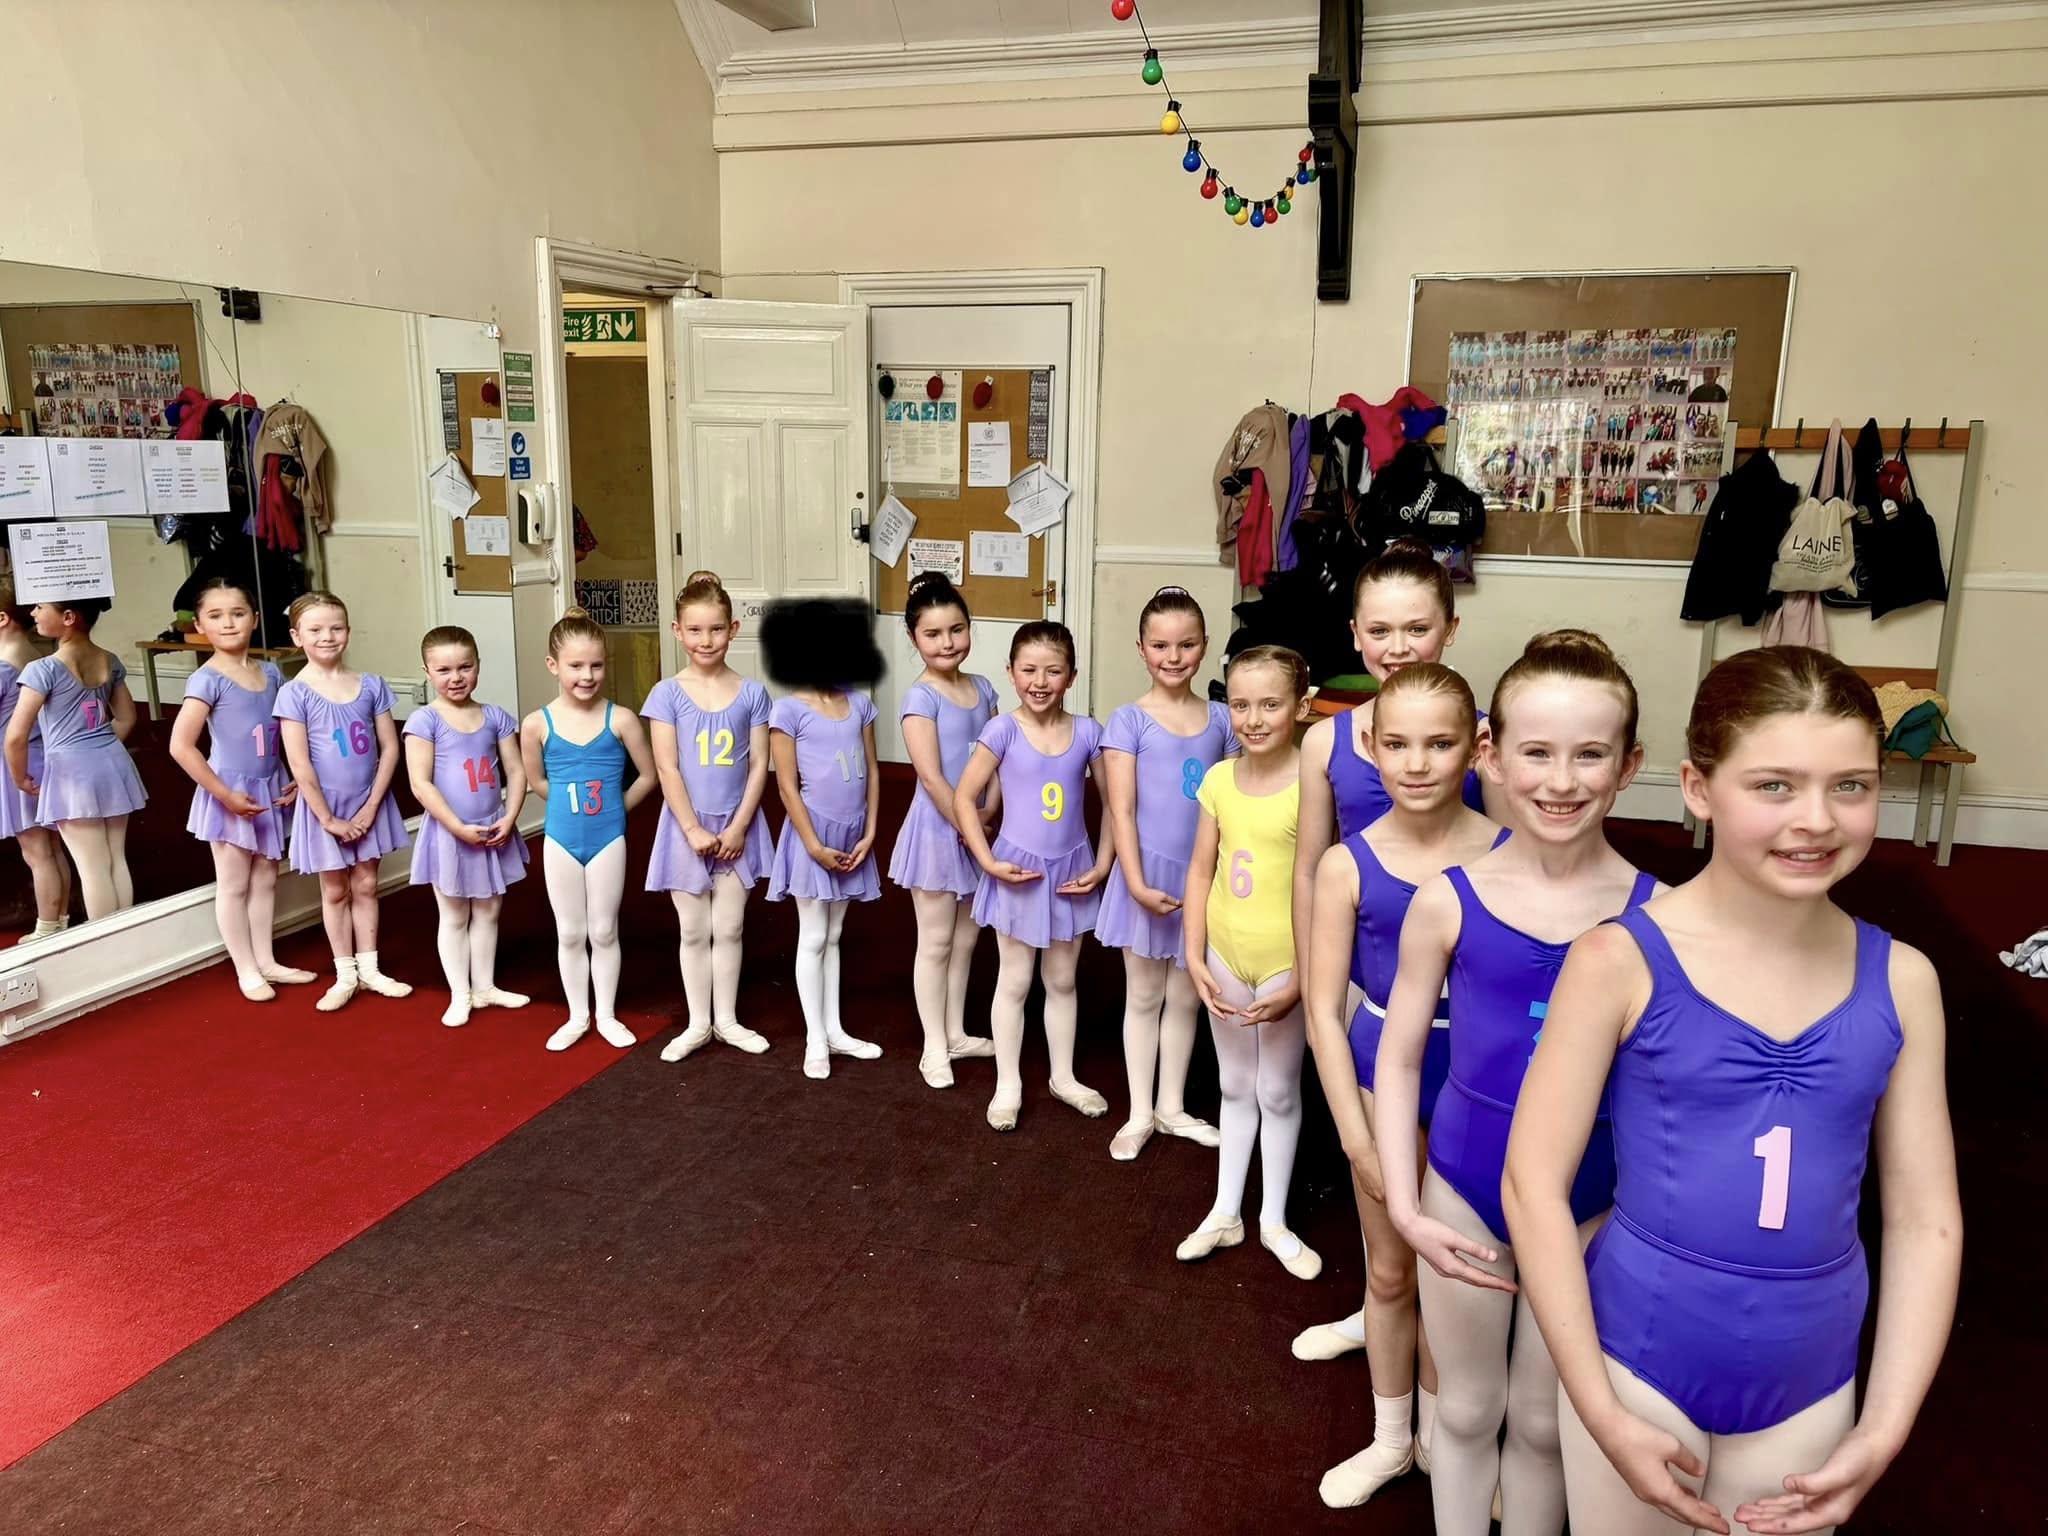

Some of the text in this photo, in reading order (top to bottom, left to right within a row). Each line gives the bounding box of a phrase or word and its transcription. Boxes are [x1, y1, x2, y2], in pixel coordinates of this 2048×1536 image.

[1792, 534, 1842, 555] LAINE
[580, 590, 620, 608] DANCE
[331, 720, 370, 758] 16
[695, 729, 735, 766] 12
[463, 756, 496, 793] 14
[834, 746, 865, 782] 11
[1182, 758, 1204, 800] 8
[566, 781, 603, 816] 13
[1041, 782, 1064, 822] 9
[1230, 849, 1254, 898] 6
[1753, 1126, 1792, 1230] 1
